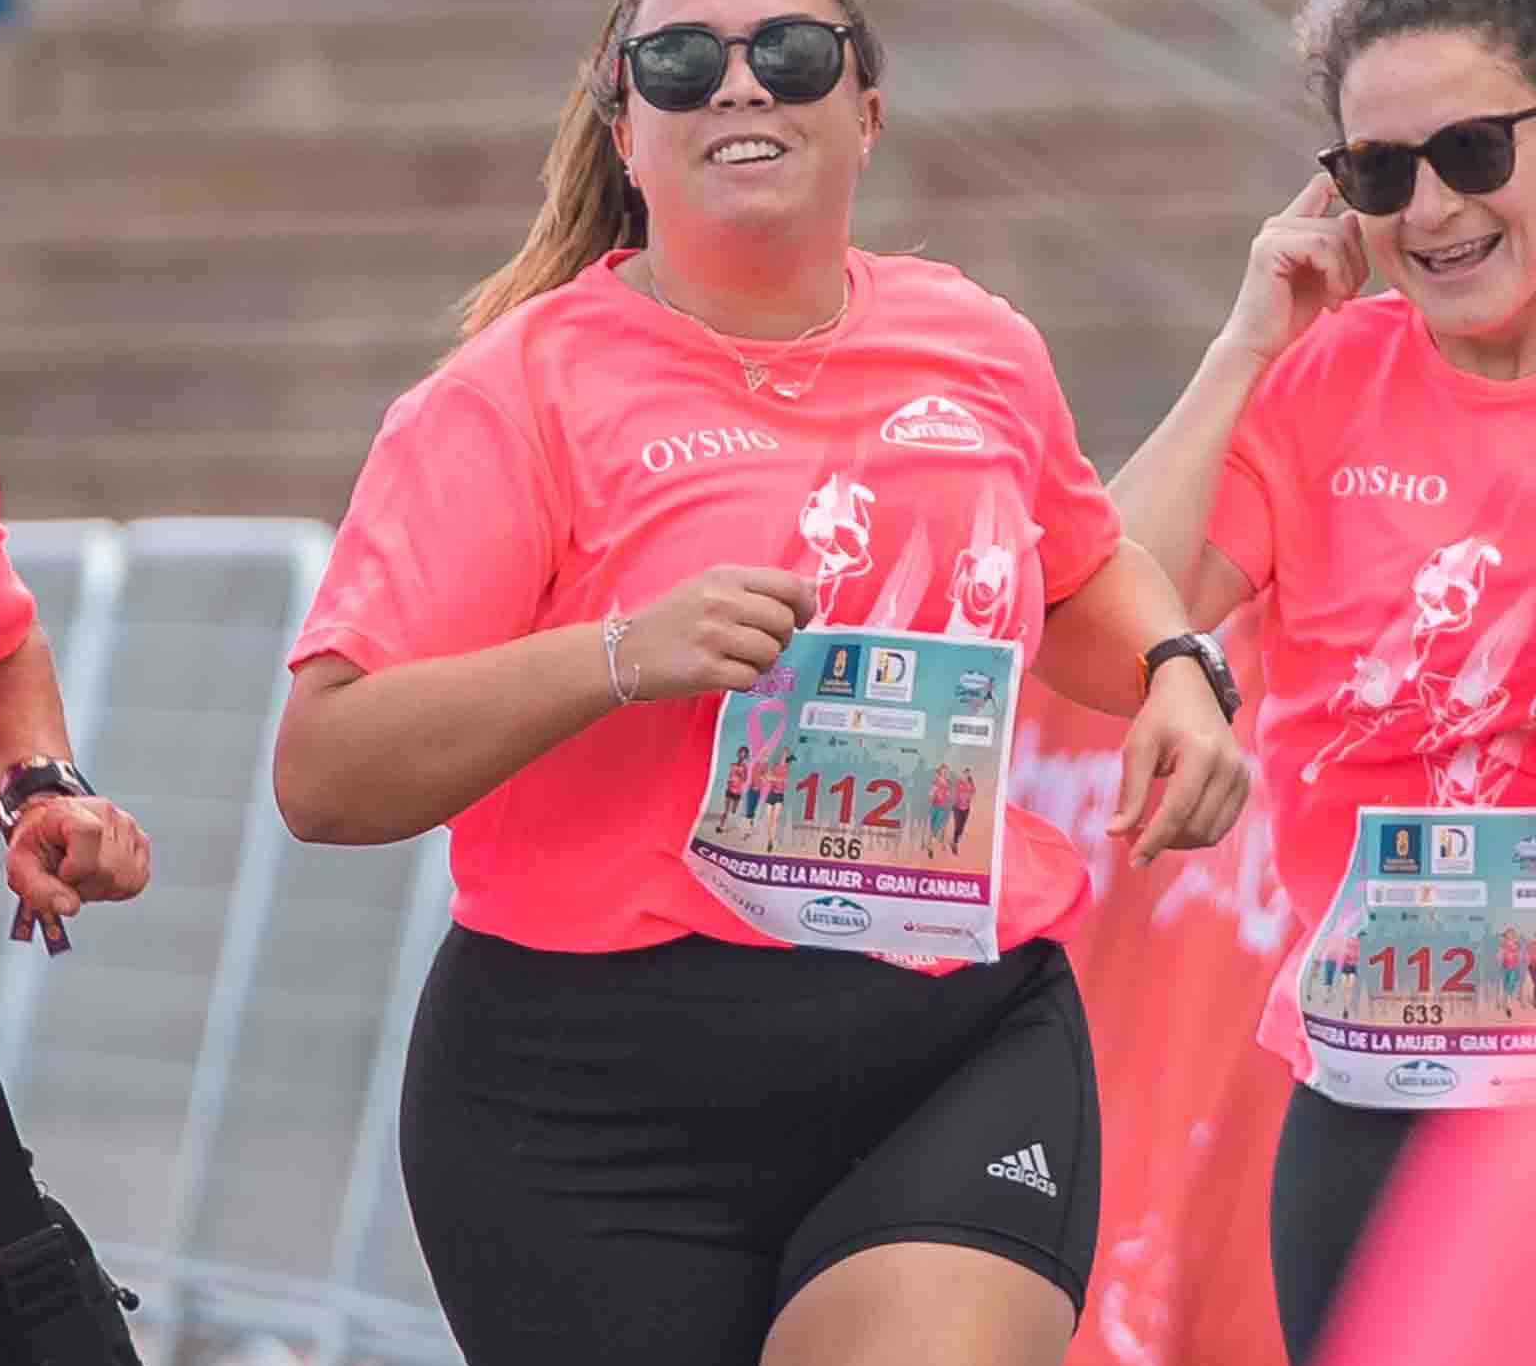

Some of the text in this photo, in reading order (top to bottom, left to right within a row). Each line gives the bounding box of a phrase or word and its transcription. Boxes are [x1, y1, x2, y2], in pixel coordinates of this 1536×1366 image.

[1331, 463, 1448, 506] OYSHO
[796, 772, 904, 829] 112
[819, 836, 862, 860] 636
[771, 864, 792, 883] DE
[793, 867, 808, 884] LA
[809, 867, 862, 889] MUJER
[875, 873, 915, 893] GRAN
[918, 878, 981, 899] CANARIA
[1369, 946, 1475, 993] 112
[1403, 1004, 1443, 1025] 633
[1347, 1031, 1368, 1049] DE
[1371, 1033, 1392, 1051] LA
[1395, 1035, 1447, 1052] MUJER
[1459, 1034, 1497, 1051] GRAN
[987, 1163, 1056, 1197] adidas
